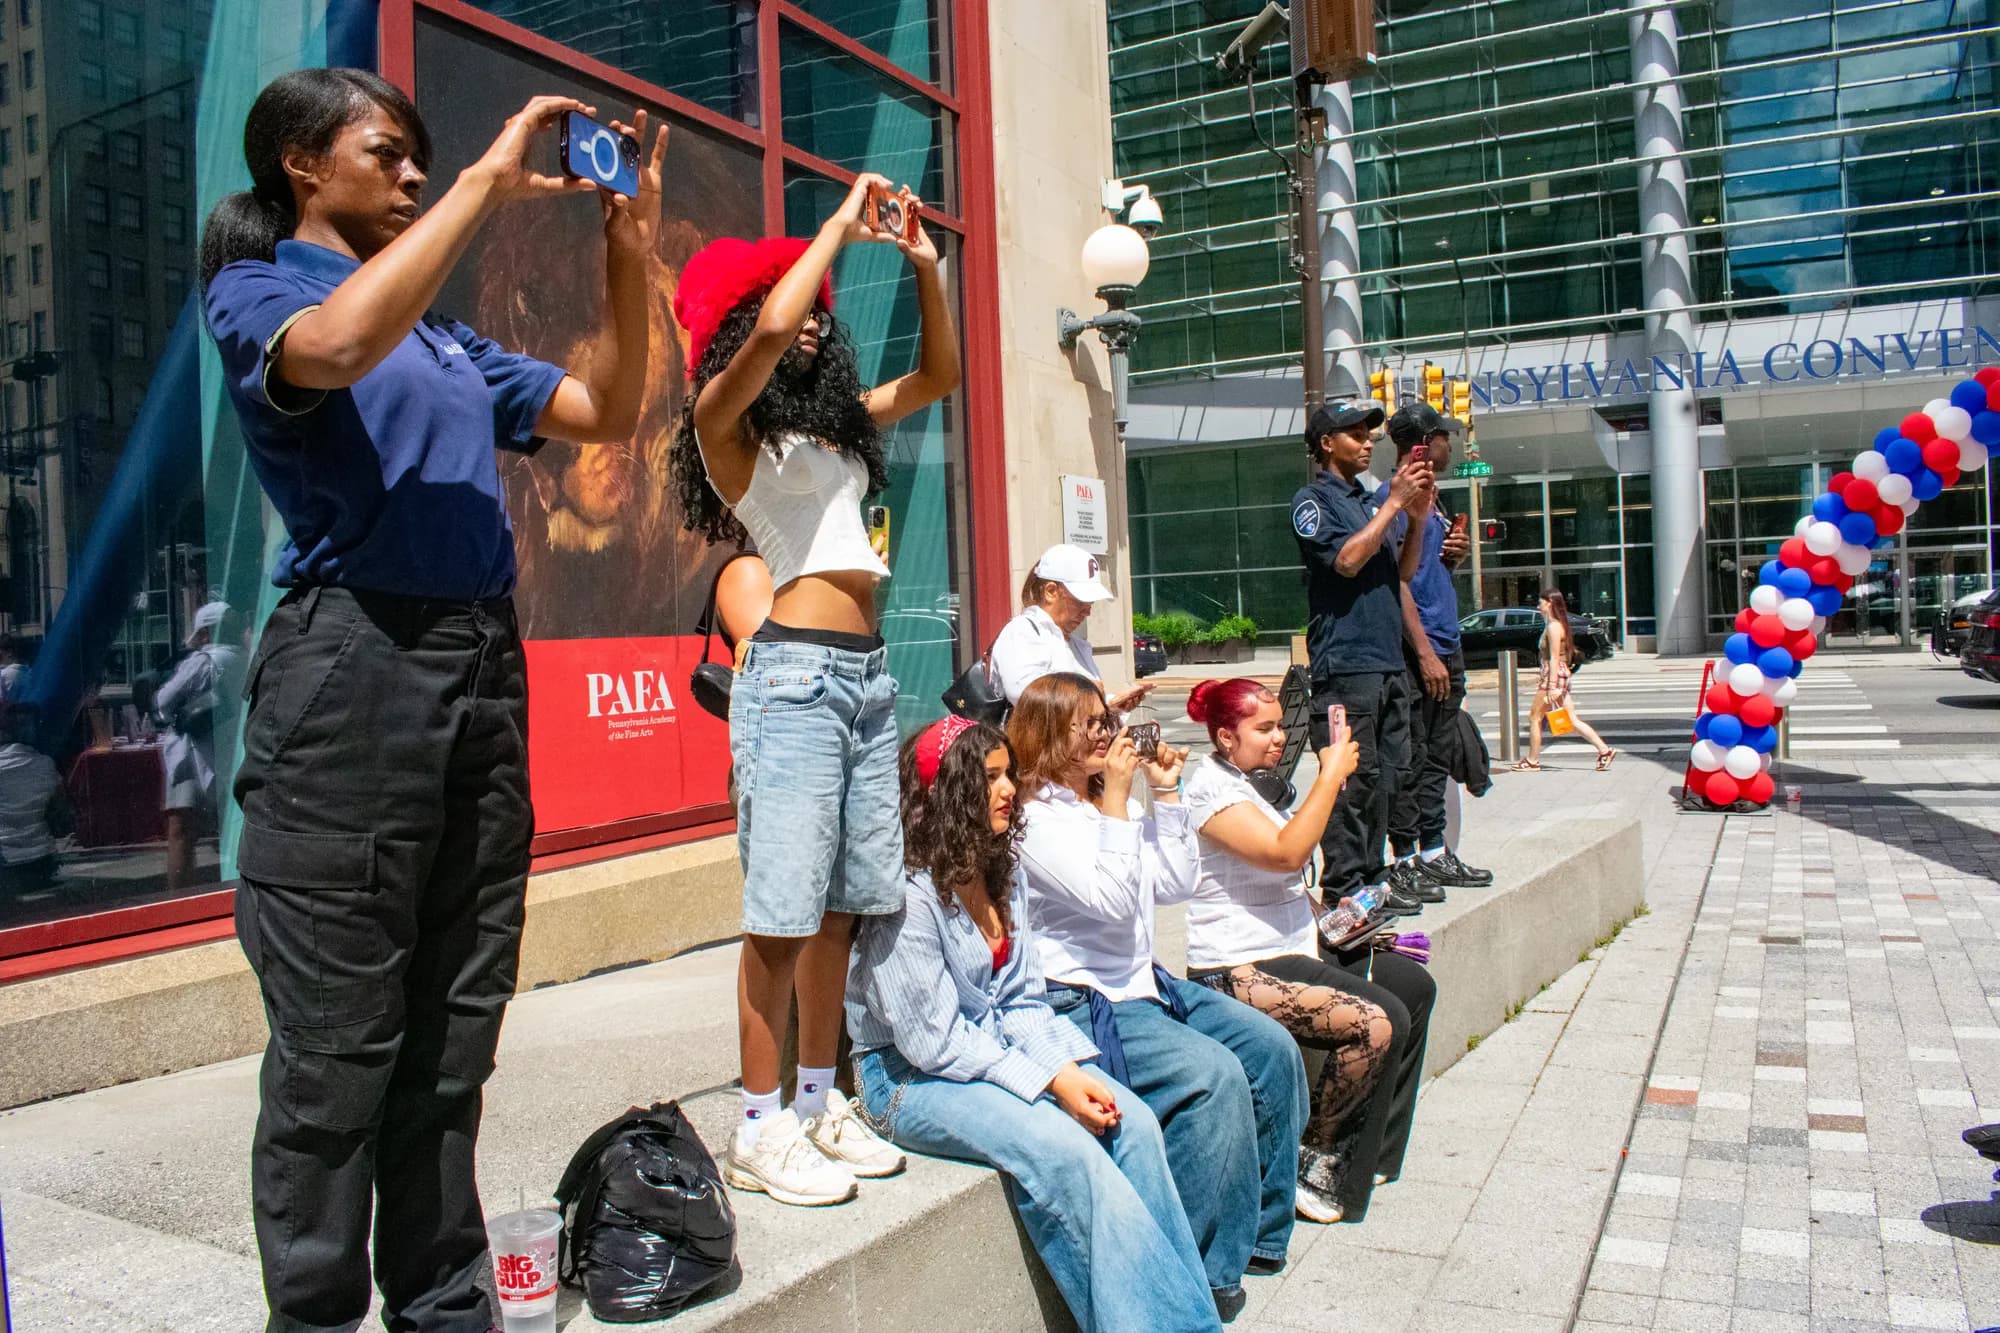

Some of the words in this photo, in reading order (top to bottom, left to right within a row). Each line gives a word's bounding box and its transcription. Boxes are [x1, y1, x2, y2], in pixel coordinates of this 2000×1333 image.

[1366, 349, 1748, 412] NSYLVANIA
[1481, 465, 1490, 475] St
[1076, 484, 1094, 500] PAFA
[585, 670, 676, 717] PAFA
[608, 716, 648, 729] Pennsylvania
[649, 714, 676, 724] Academy
[625, 729, 639, 739] Fine
[640, 728, 653, 737] Arts
[496, 1269, 541, 1289] GULP
